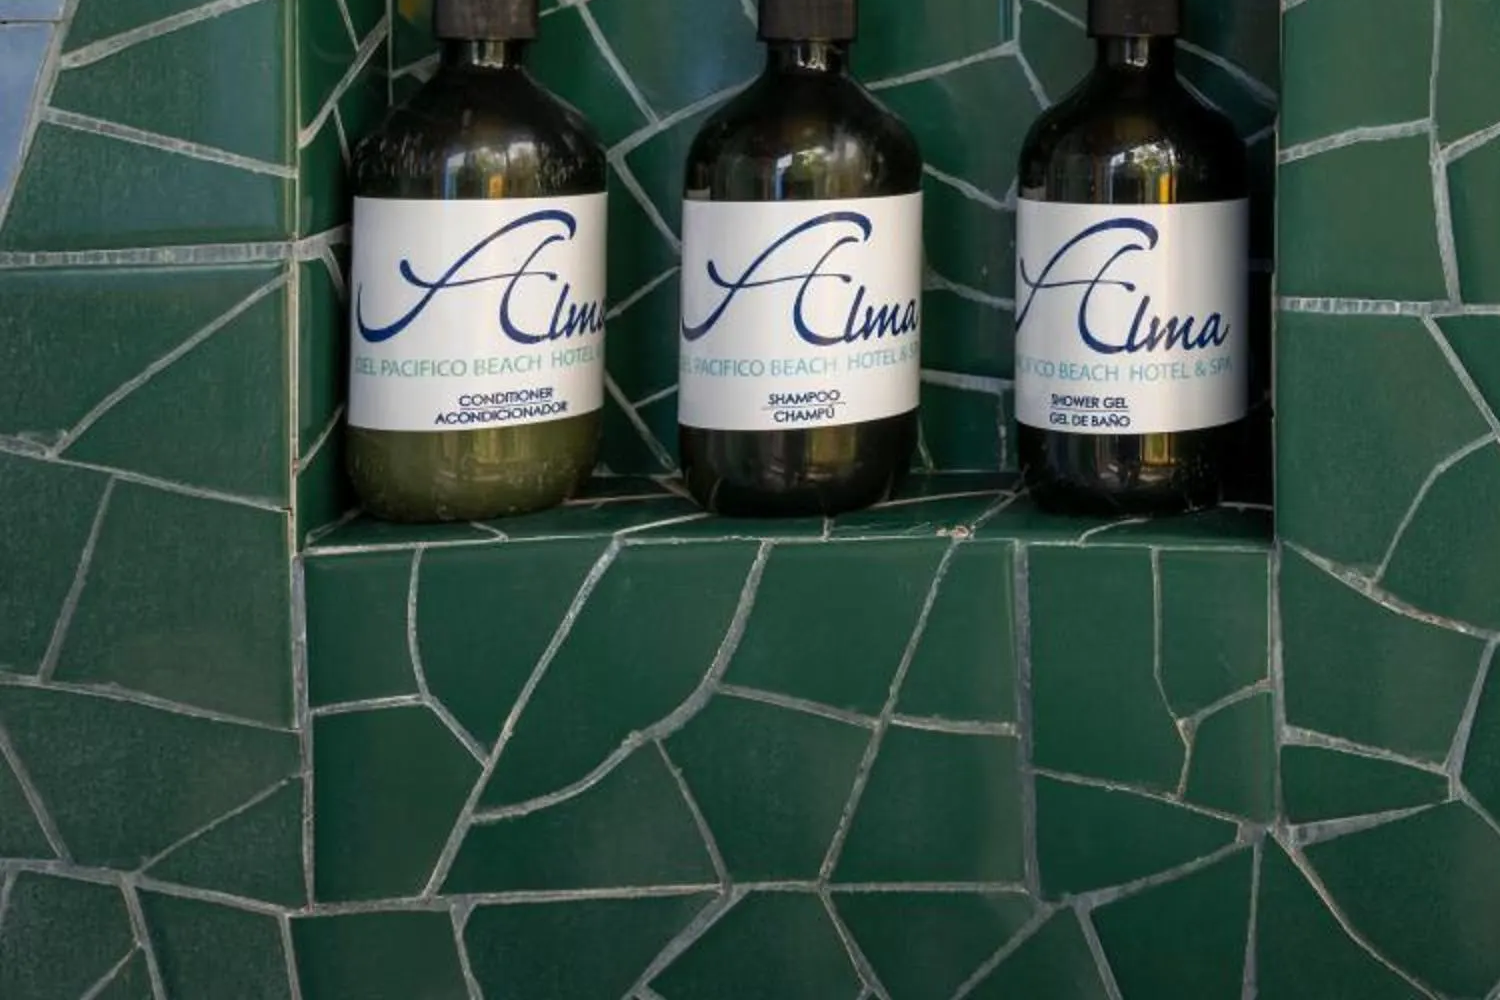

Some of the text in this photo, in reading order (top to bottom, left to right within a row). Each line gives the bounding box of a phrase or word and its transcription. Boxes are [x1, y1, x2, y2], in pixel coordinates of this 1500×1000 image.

[682, 211, 918, 346] Alma
[1016, 217, 1231, 354] Alma
[381, 358, 467, 378] PACIFICO
[473, 354, 542, 377] BEACH
[770, 357, 838, 377] BEACH
[847, 348, 897, 371] HOTEL
[1059, 361, 1119, 382] BEACH
[1130, 361, 1190, 382] HOTEL
[1194, 360, 1207, 378] &
[459, 386, 553, 407] CONDITIONER
[768, 389, 840, 406] SHAMPOO
[1052, 393, 1129, 410] SHOWER GEL
[434, 401, 569, 425] ACONDICIONADOR
[773, 405, 836, 424] CHAMPÚ
[1049, 410, 1131, 428] GEL DE BAÑO
